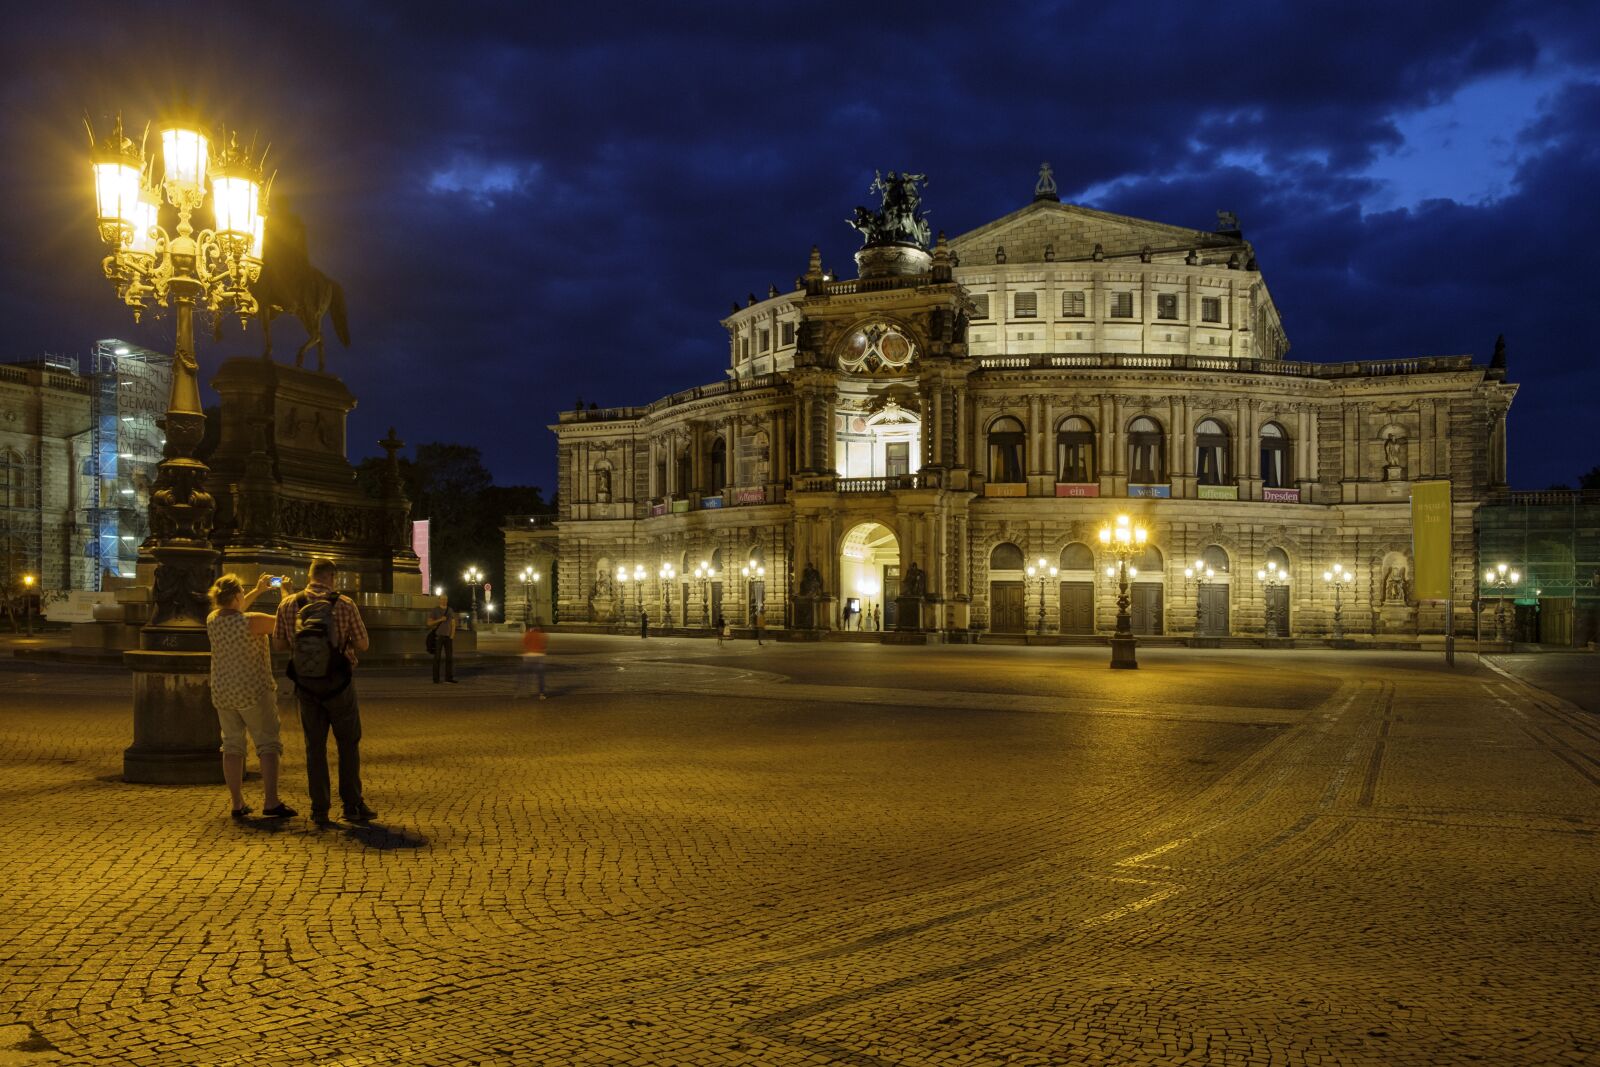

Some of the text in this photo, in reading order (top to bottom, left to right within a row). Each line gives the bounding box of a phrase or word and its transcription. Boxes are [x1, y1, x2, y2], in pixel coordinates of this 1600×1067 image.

[135, 381, 157, 399] DER
[1069, 485, 1085, 496] ein
[1137, 486, 1160, 497] welt-
[1201, 489, 1234, 499] offenes
[1264, 491, 1299, 501] Dresden
